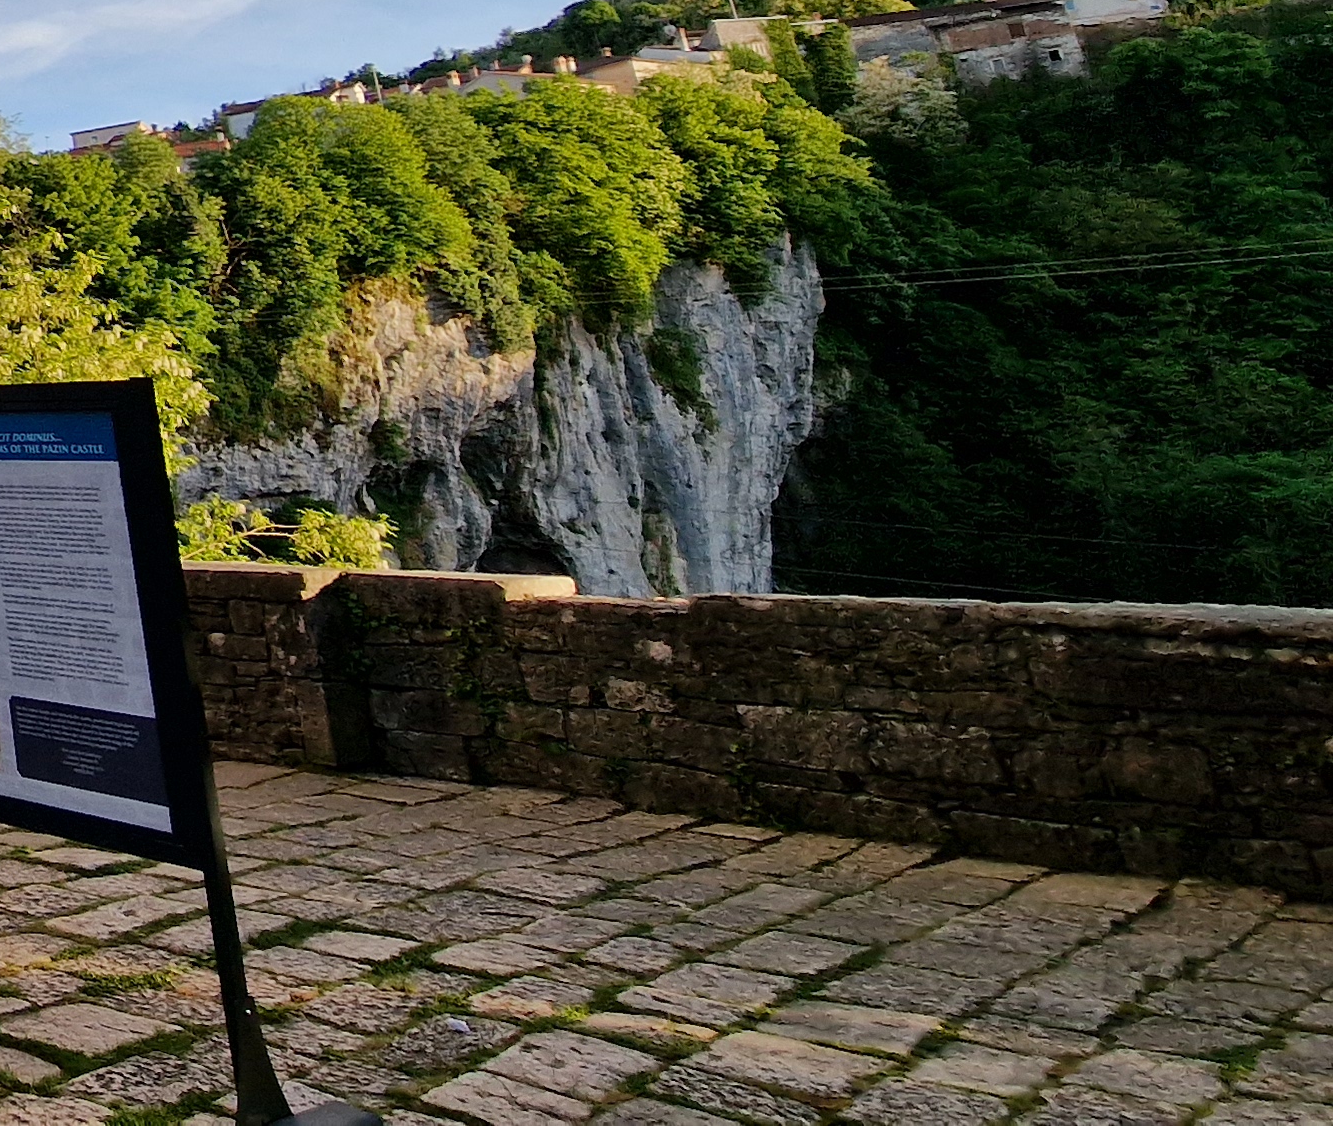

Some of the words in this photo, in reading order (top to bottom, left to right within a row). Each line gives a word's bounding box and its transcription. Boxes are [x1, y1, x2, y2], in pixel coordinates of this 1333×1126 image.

[10, 444, 22, 454] OF
[23, 444, 41, 454] THE
[42, 444, 69, 454] PAZIN
[70, 444, 105, 454] CASTLE
